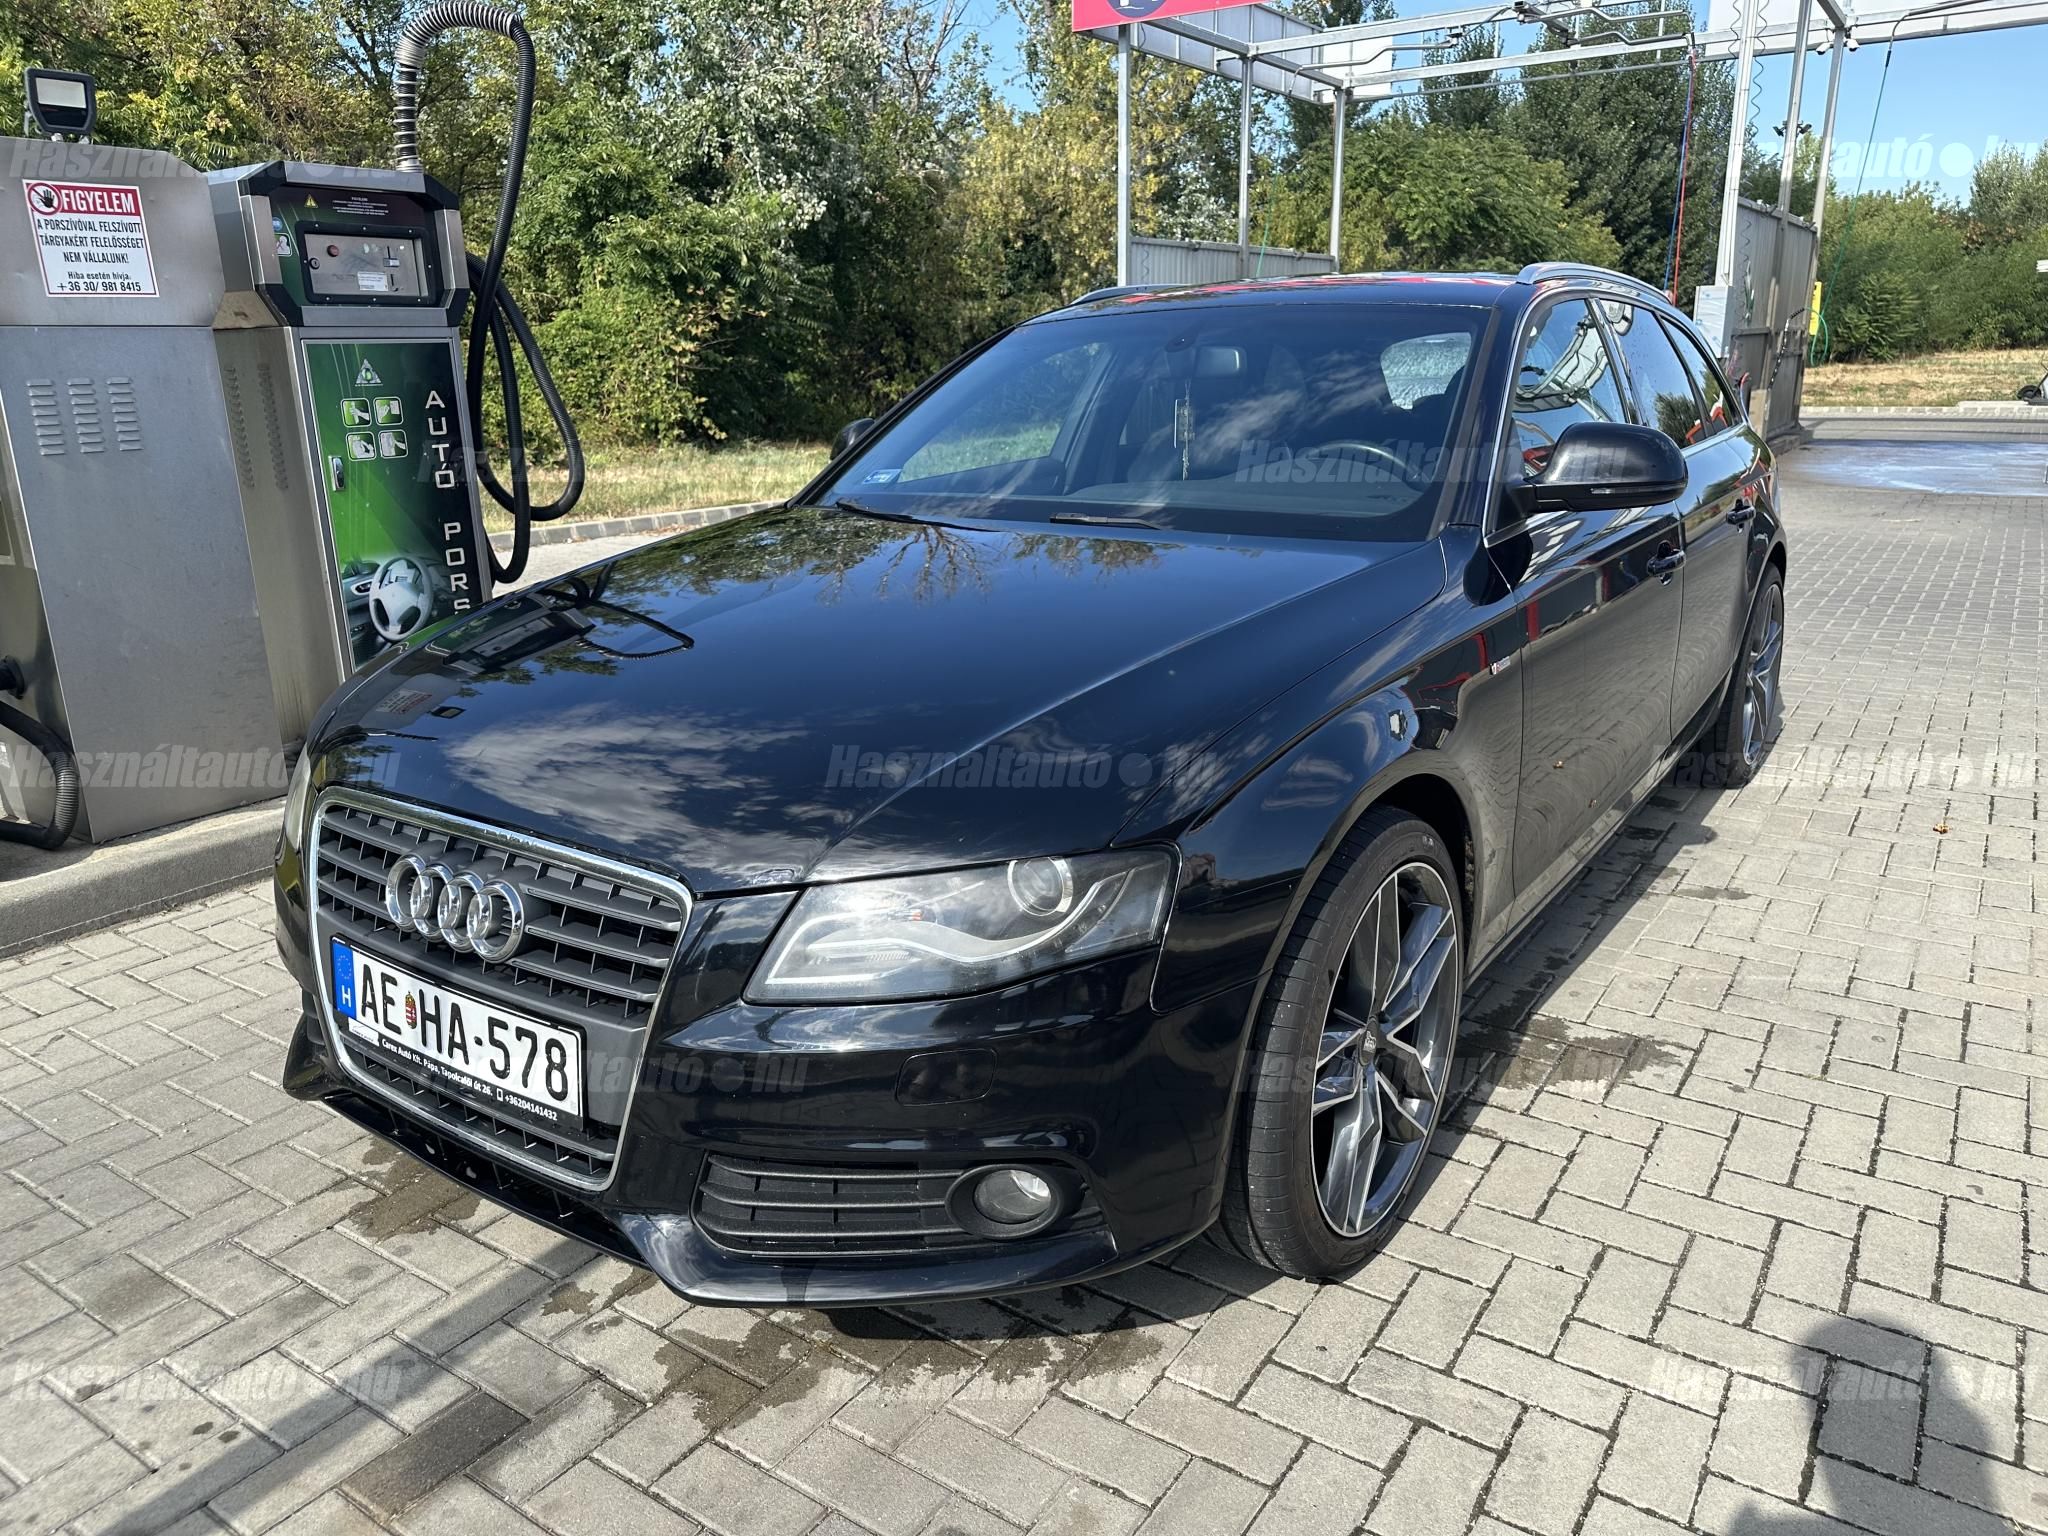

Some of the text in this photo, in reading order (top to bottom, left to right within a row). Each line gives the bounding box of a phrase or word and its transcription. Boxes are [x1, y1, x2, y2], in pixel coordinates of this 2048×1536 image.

[60, 189, 136, 214] FIGYELEM
[37, 218, 142, 233] A PORSZÍVÓVAL FELSZÍVOTT
[40, 233, 144, 249] TÁRGYAKÉRT FELELŐSSÉGET
[63, 250, 129, 264] NEM VÁLLALUNK!
[67, 271, 85, 280] Hiba
[86, 272, 111, 280] esetén
[102, 281, 118, 291] 981
[121, 281, 142, 292] 8415
[425, 390, 455, 489] AUTÓ
[341, 985, 352, 1009] H
[361, 963, 402, 1036] AE
